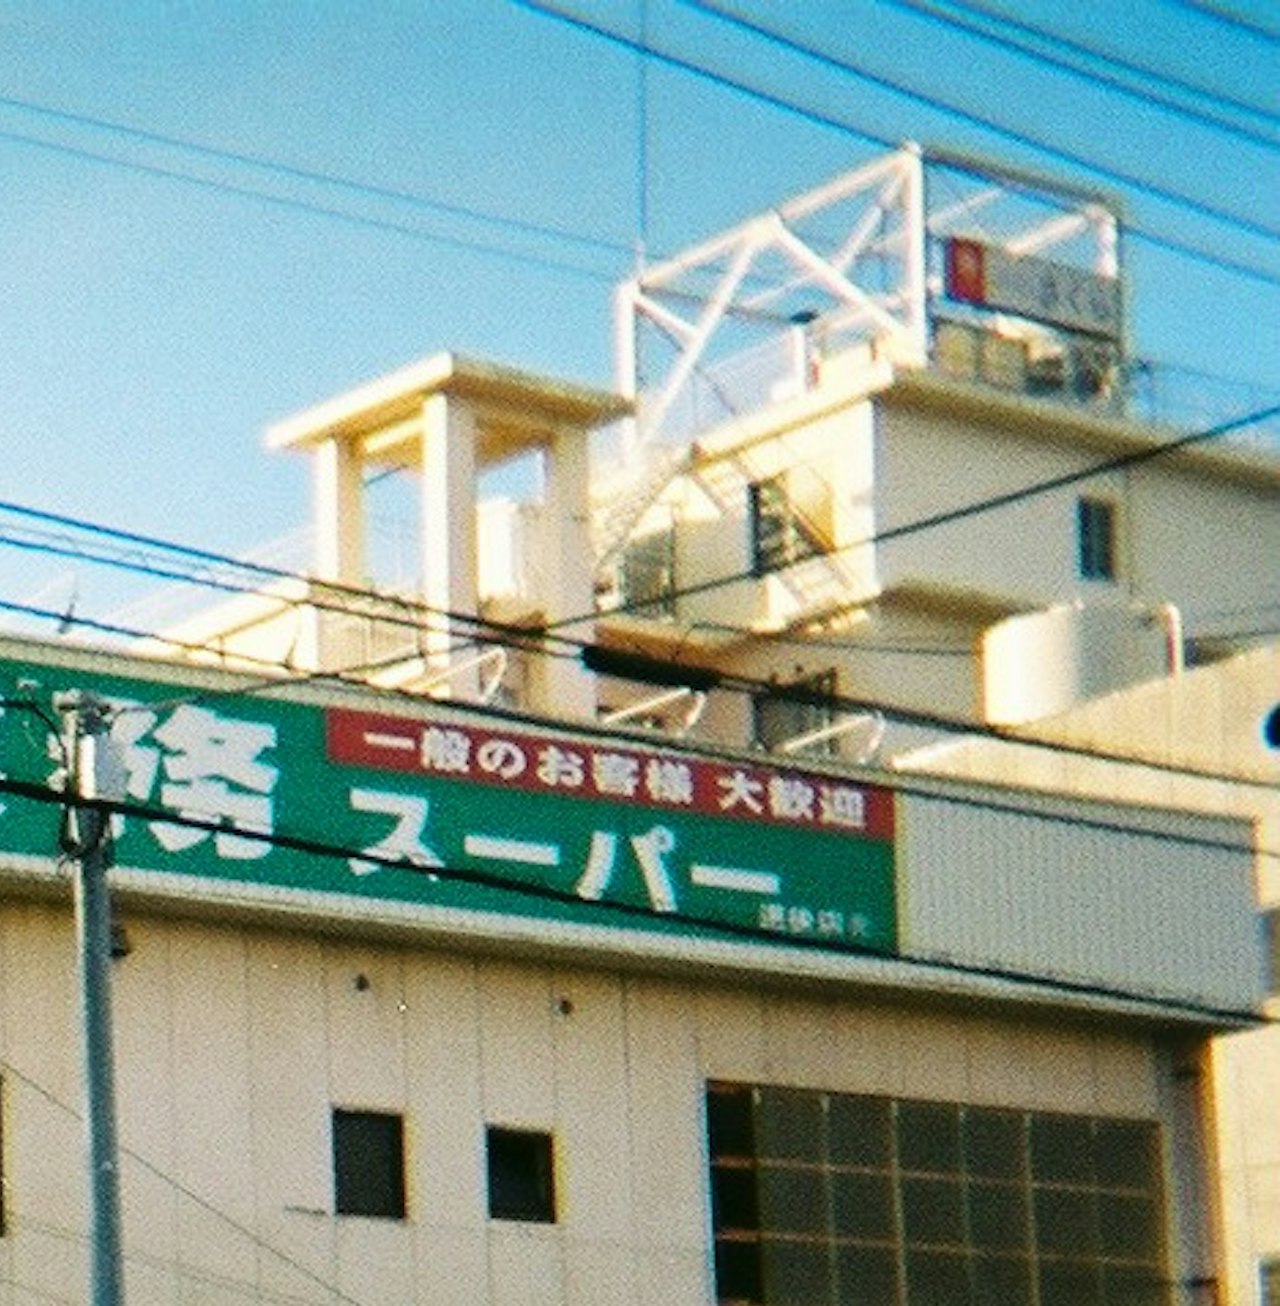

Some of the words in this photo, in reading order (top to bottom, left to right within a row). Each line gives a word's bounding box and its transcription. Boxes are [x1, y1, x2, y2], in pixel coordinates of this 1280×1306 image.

[363, 726, 693, 805] 一般のお客様
[717, 770, 866, 830] 大歓迎
